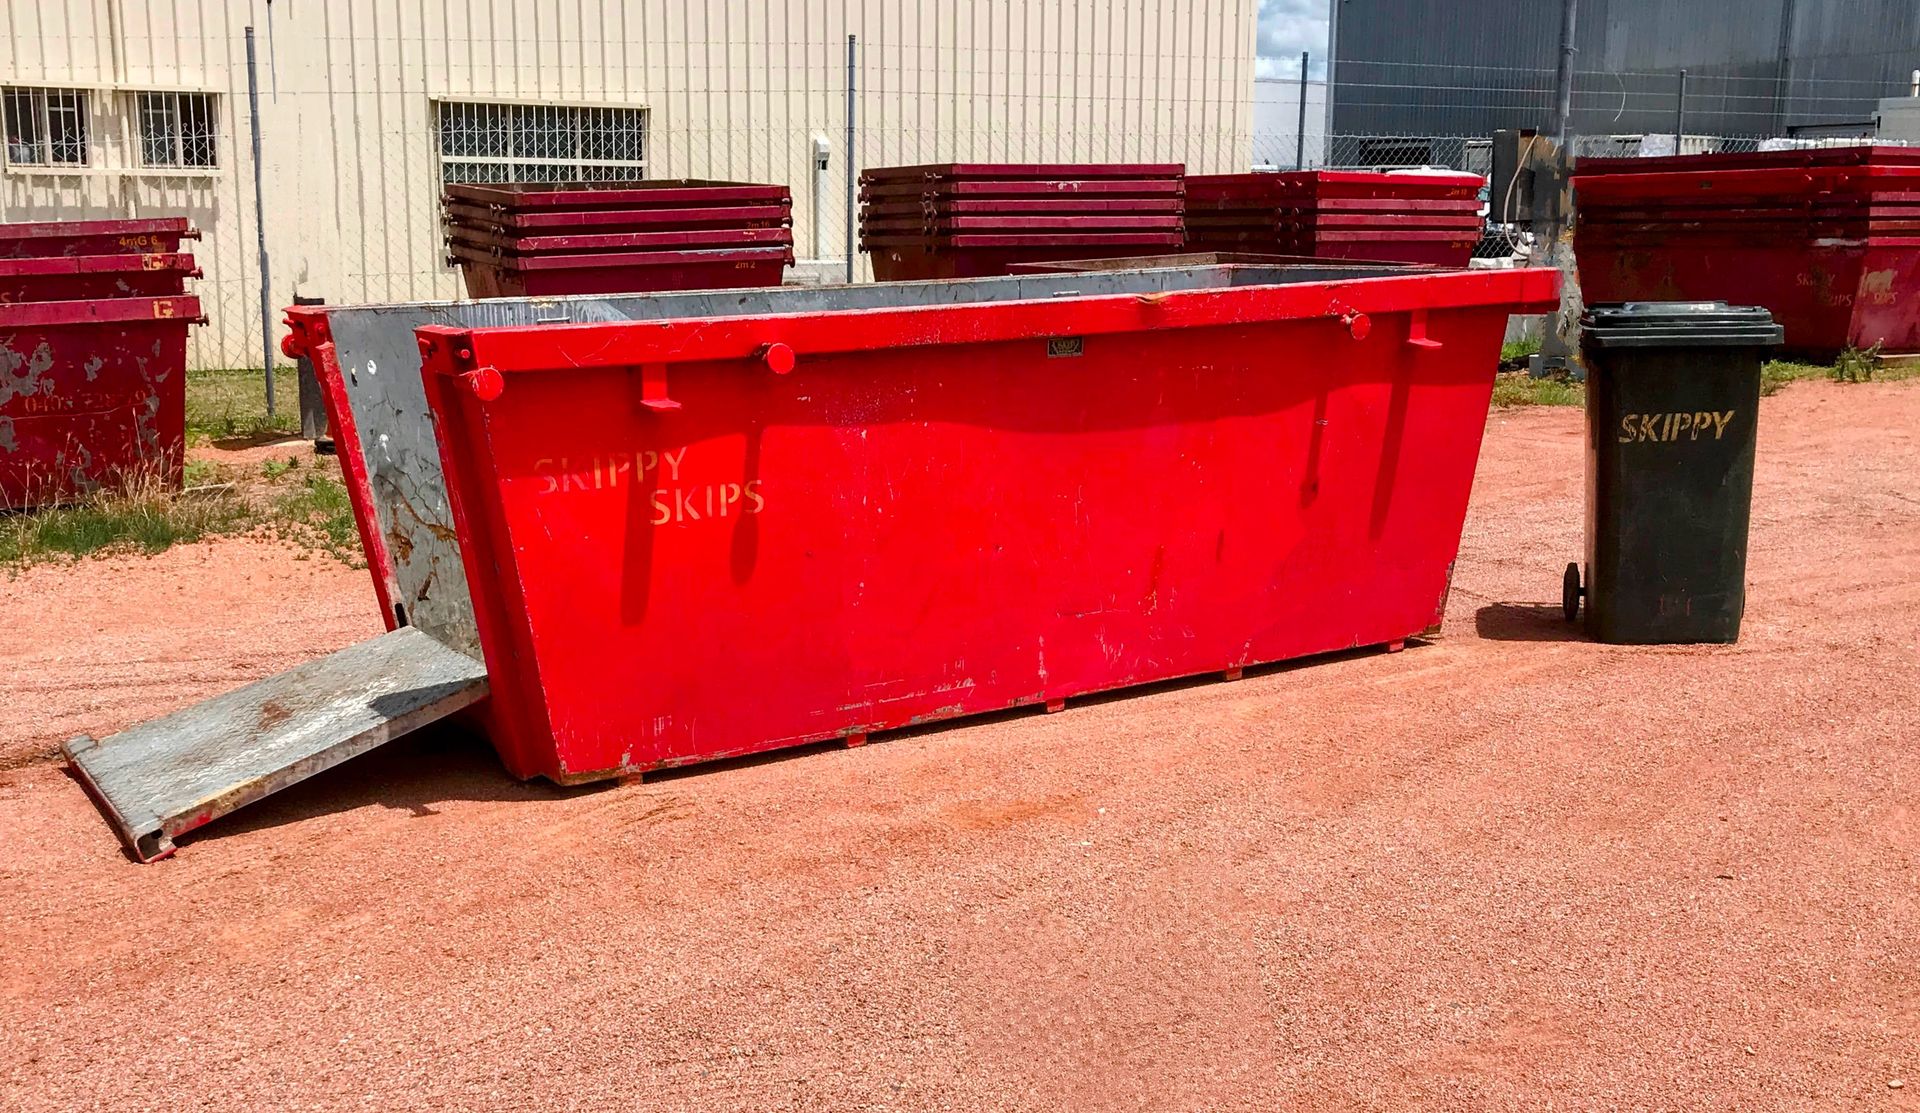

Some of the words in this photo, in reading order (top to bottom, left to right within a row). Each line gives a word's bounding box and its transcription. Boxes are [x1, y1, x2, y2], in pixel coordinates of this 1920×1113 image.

[1619, 410, 1736, 443] SKIPPY
[534, 446, 688, 495] SKIPPY
[649, 479, 765, 526] SKIPS
